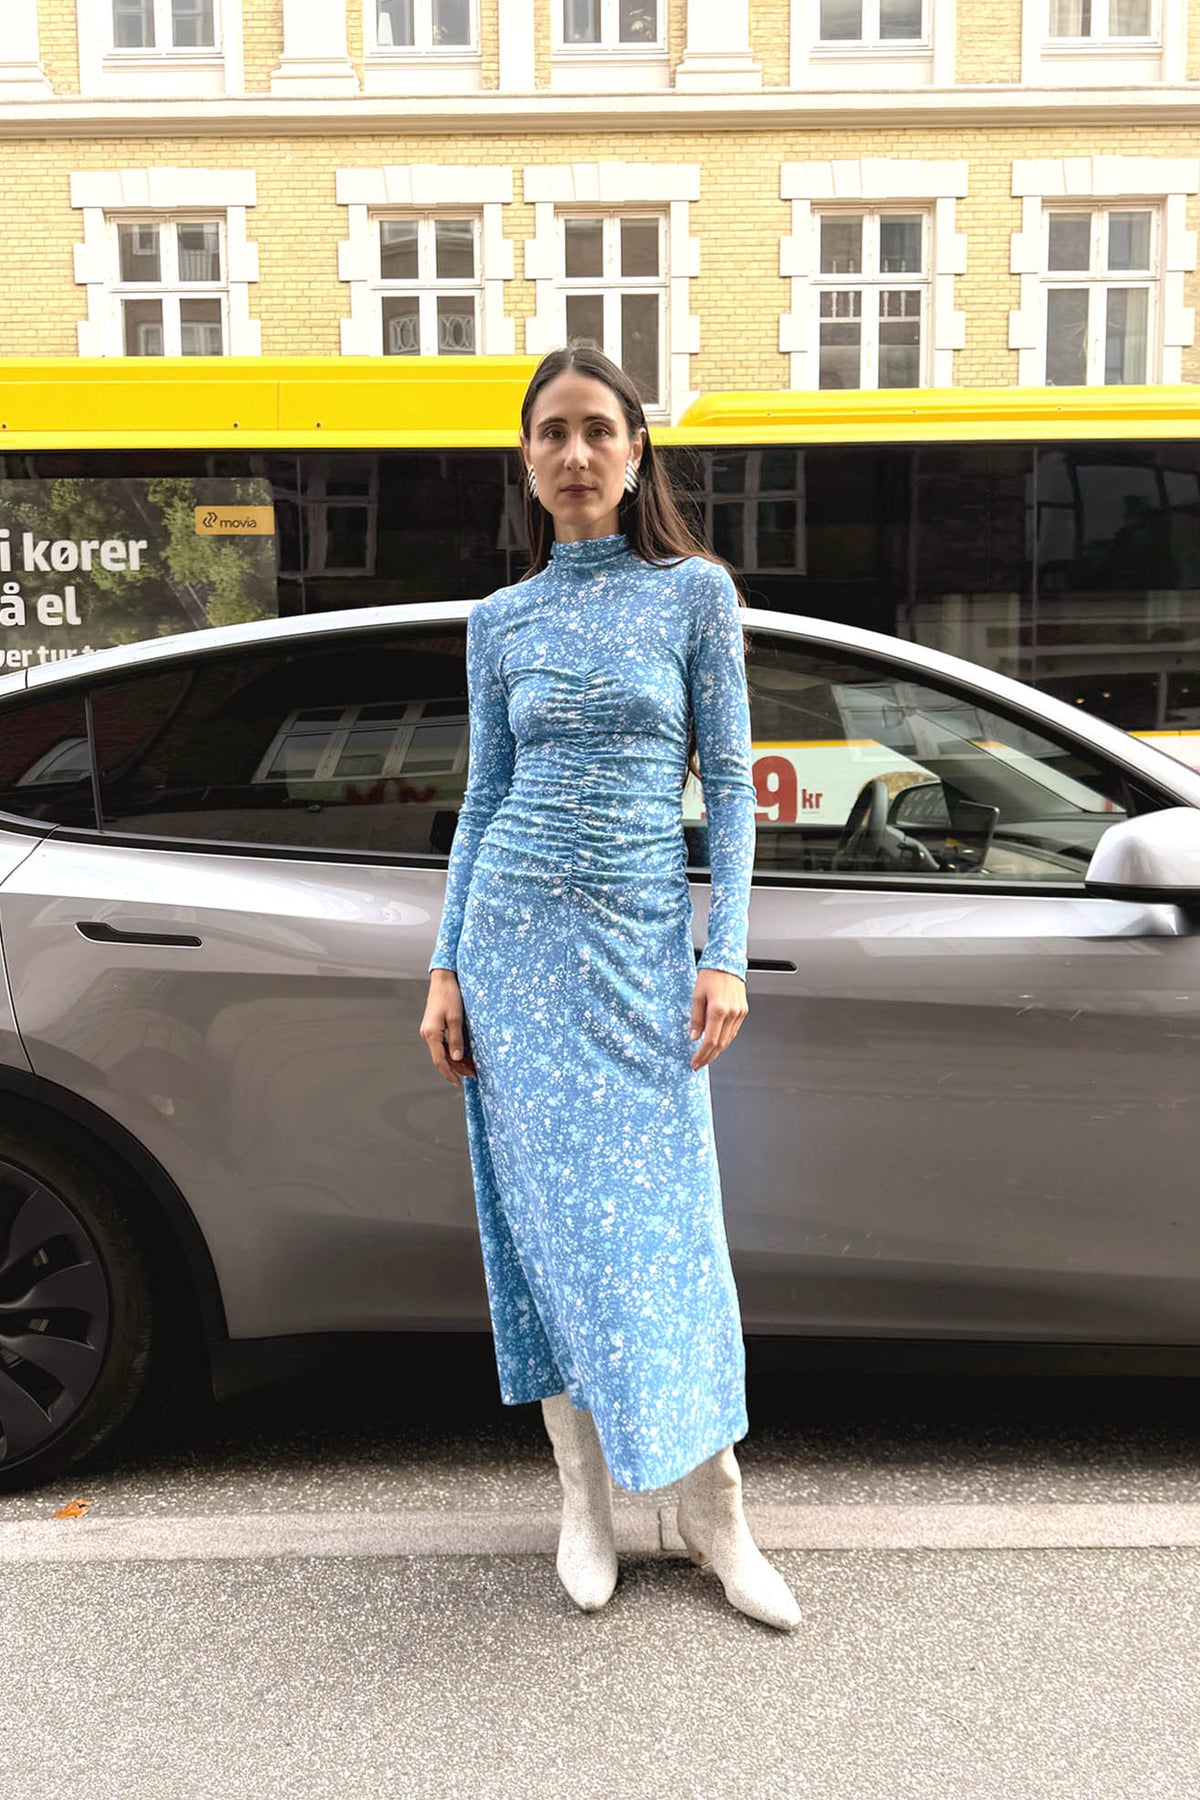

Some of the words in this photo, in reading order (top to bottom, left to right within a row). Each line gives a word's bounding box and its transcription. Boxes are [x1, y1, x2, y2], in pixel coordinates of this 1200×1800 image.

[220, 516, 257, 528] movia
[23, 532, 148, 571] kører
[37, 586, 82, 625] el
[801, 788, 823, 809] kr
